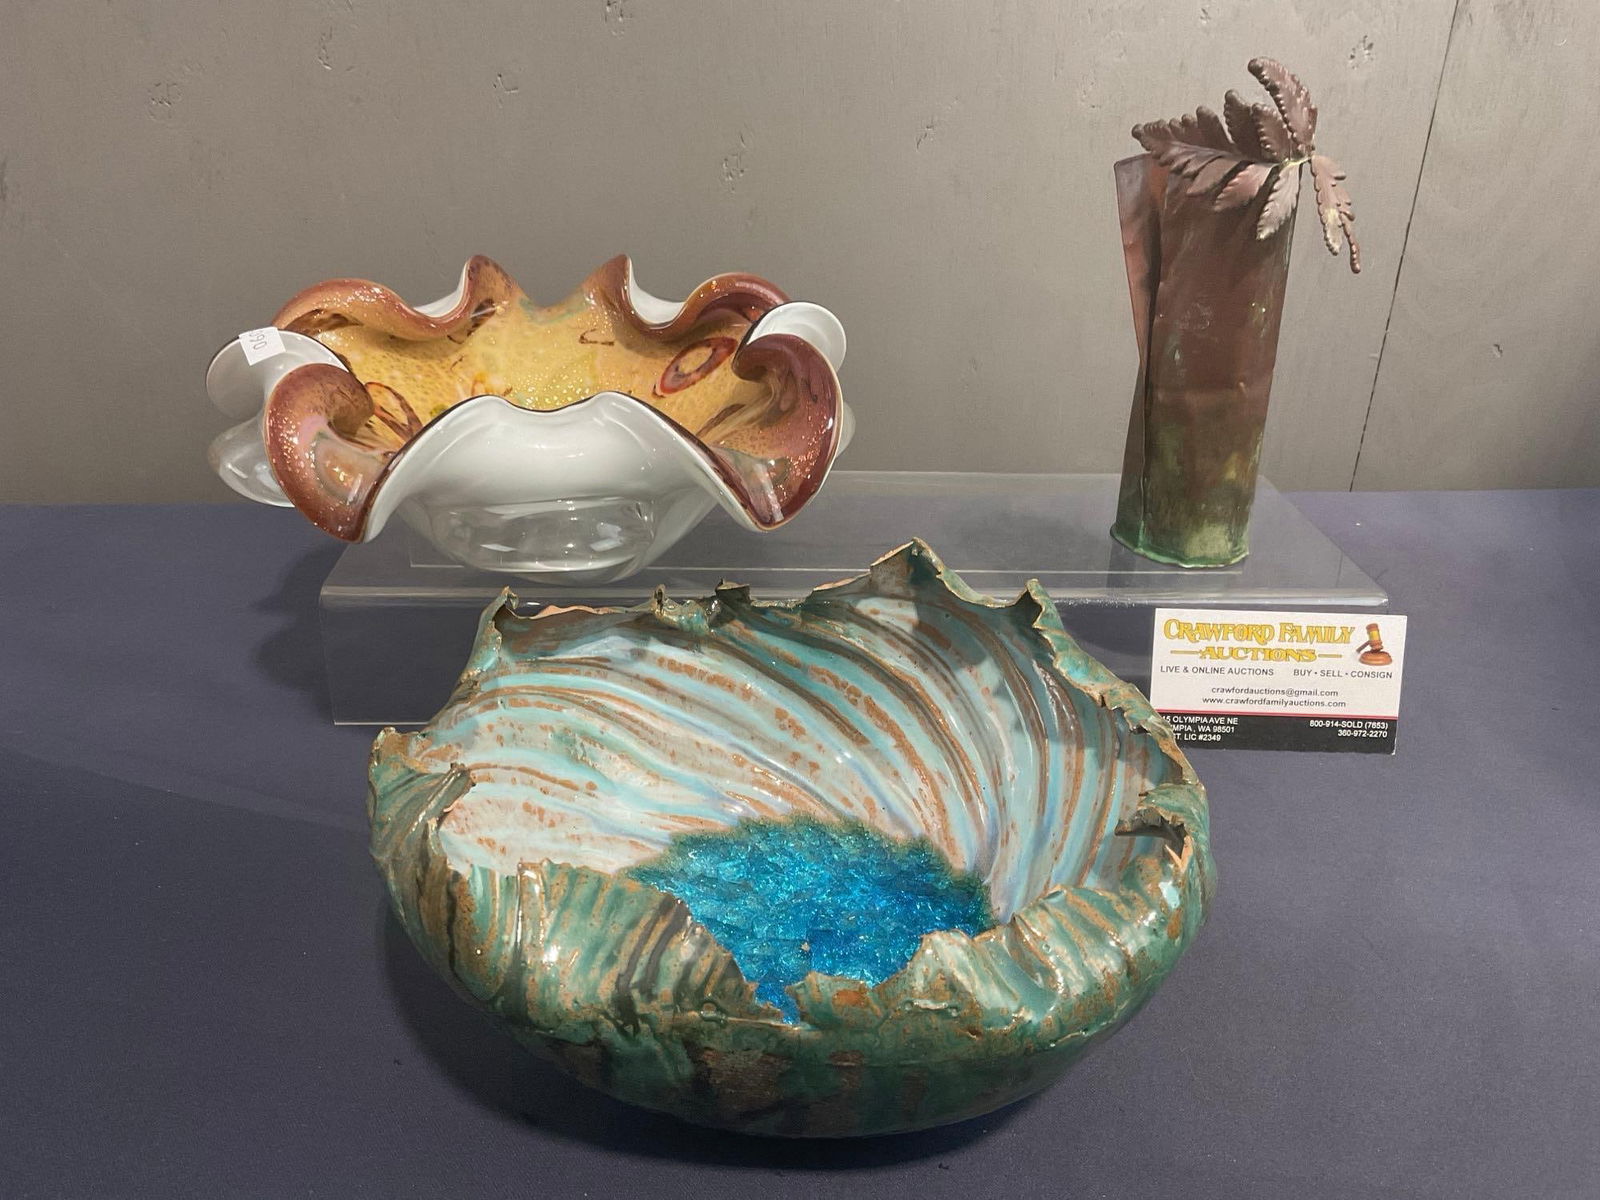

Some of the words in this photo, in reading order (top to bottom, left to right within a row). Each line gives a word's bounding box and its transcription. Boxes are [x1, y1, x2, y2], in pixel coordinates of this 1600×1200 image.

[1163, 618, 1275, 645] CRAWFORD
[1278, 622, 1356, 645] FAMILY
[1199, 646, 1318, 663] AUCTIONS
[1160, 665, 1180, 673] LIVE
[1191, 666, 1225, 675] ONLINE
[1227, 667, 1274, 676] AUCTIONS
[1293, 668, 1313, 677] BUY
[1319, 669, 1343, 677] SELL
[1350, 670, 1393, 679] CONSIGN
[1211, 686, 1339, 698] crawfordauctions@gmail.com
[1201, 697, 1347, 708] www.crawfordfamilyauctions.com
[1172, 716, 1208, 724] OLYMPIA
[1208, 716, 1225, 725] AVE
[1226, 717, 1239, 725] NE
[1309, 719, 1363, 729] 800-914-SOLD
[1337, 729, 1388, 738] 360-972-2270
